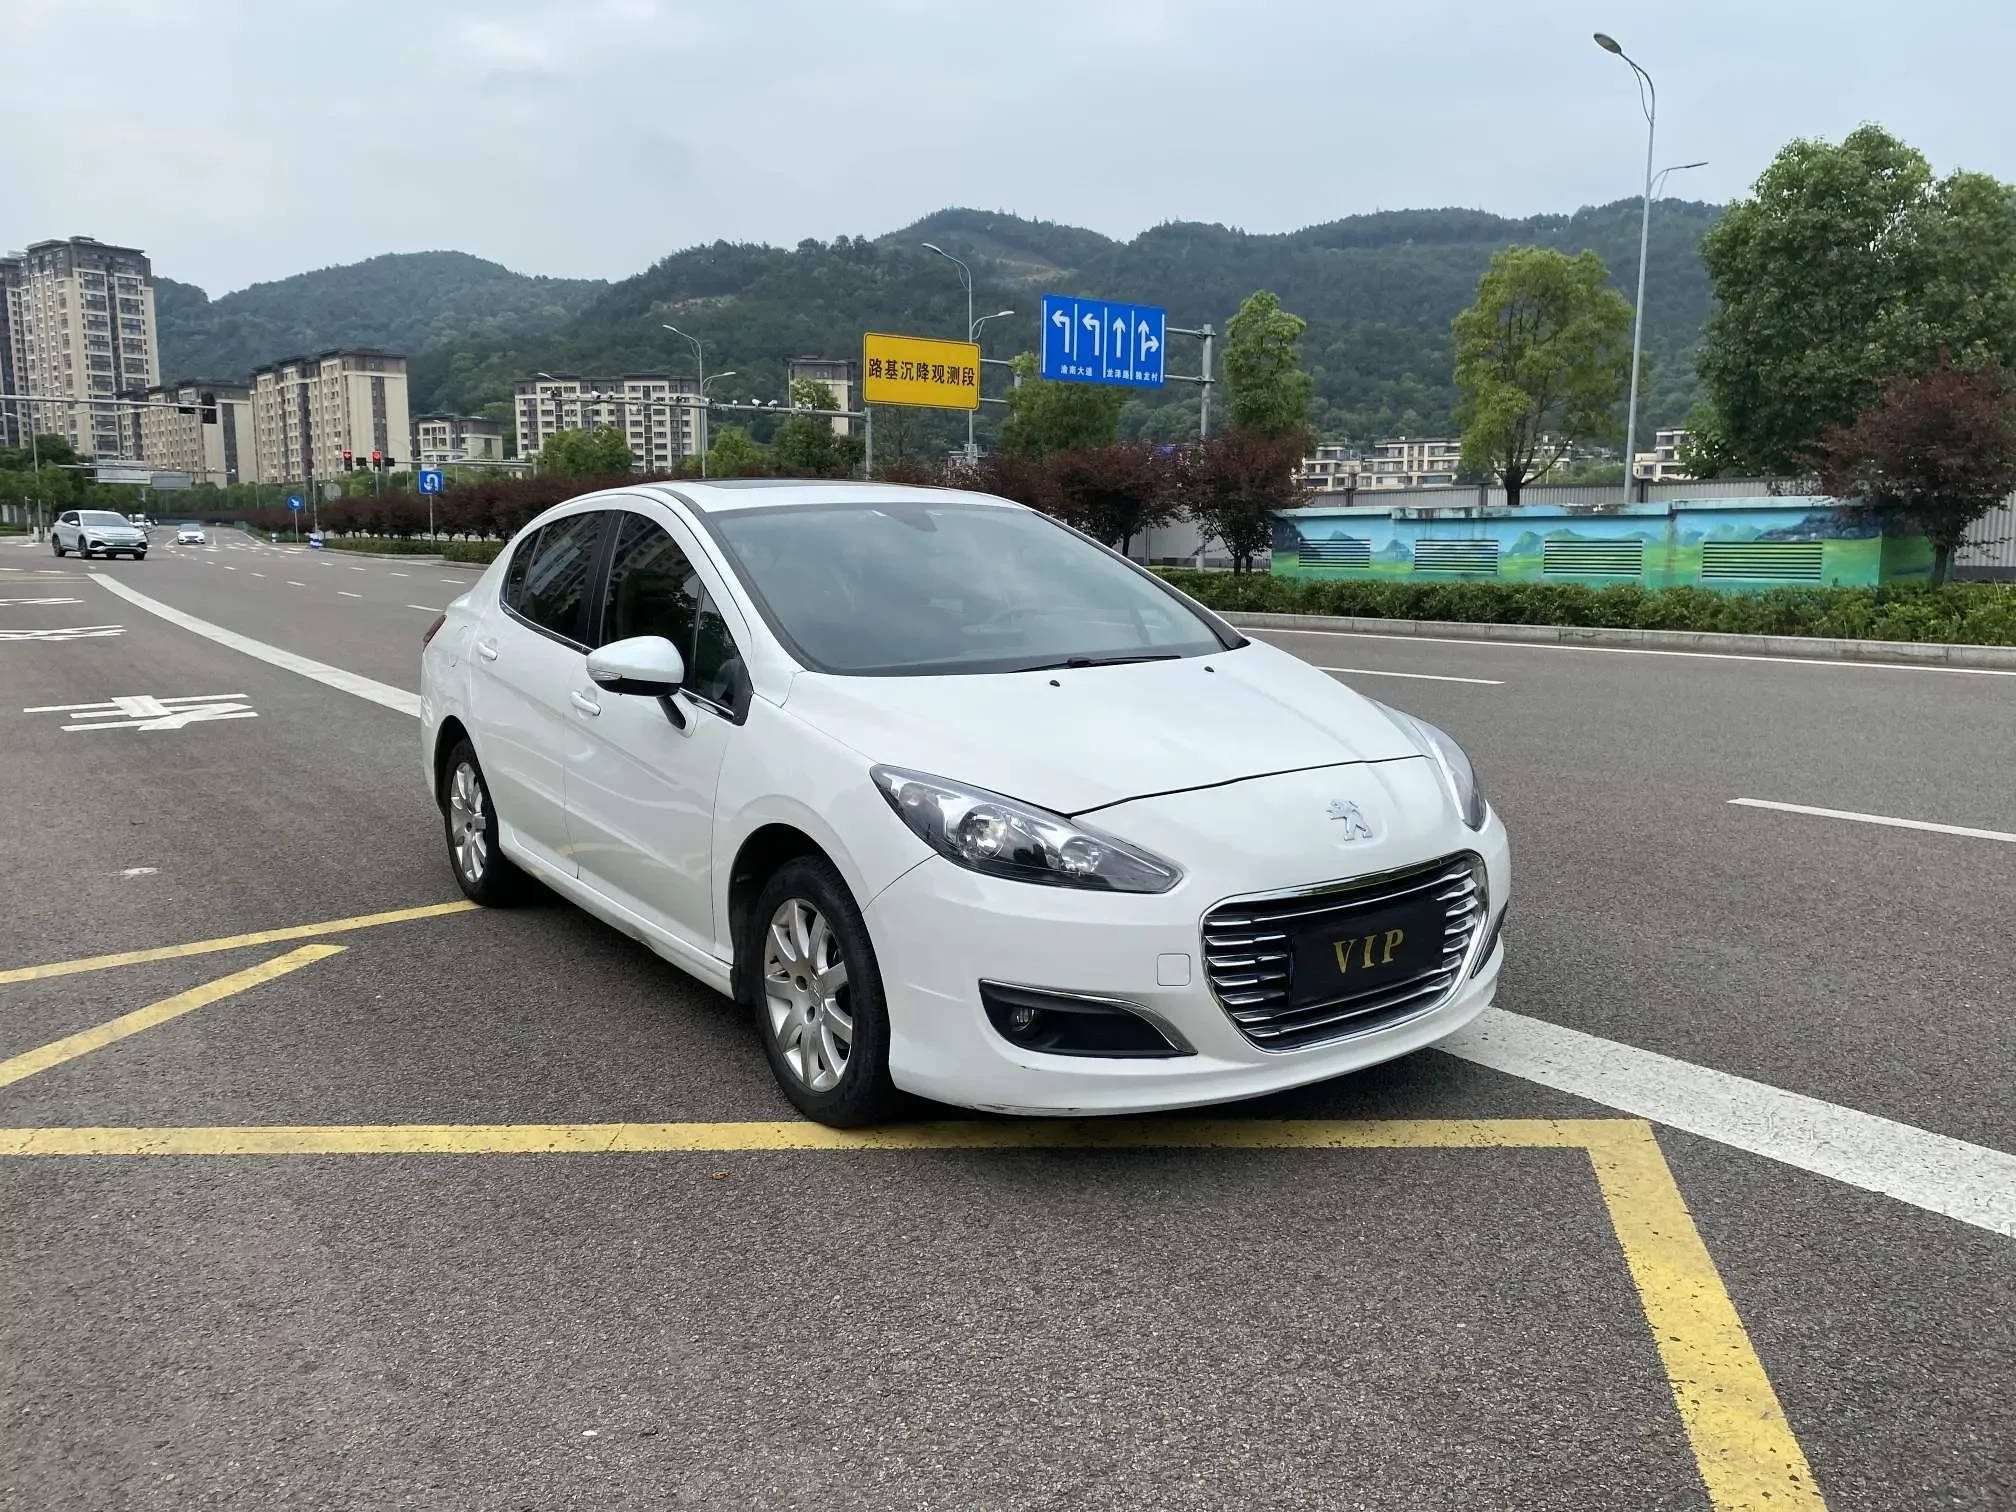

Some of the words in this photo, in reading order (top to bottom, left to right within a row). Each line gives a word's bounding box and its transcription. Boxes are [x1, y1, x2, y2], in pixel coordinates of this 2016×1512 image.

[868, 357, 975, 387] 路基沉降观测段
[1333, 929, 1404, 974] VIP
